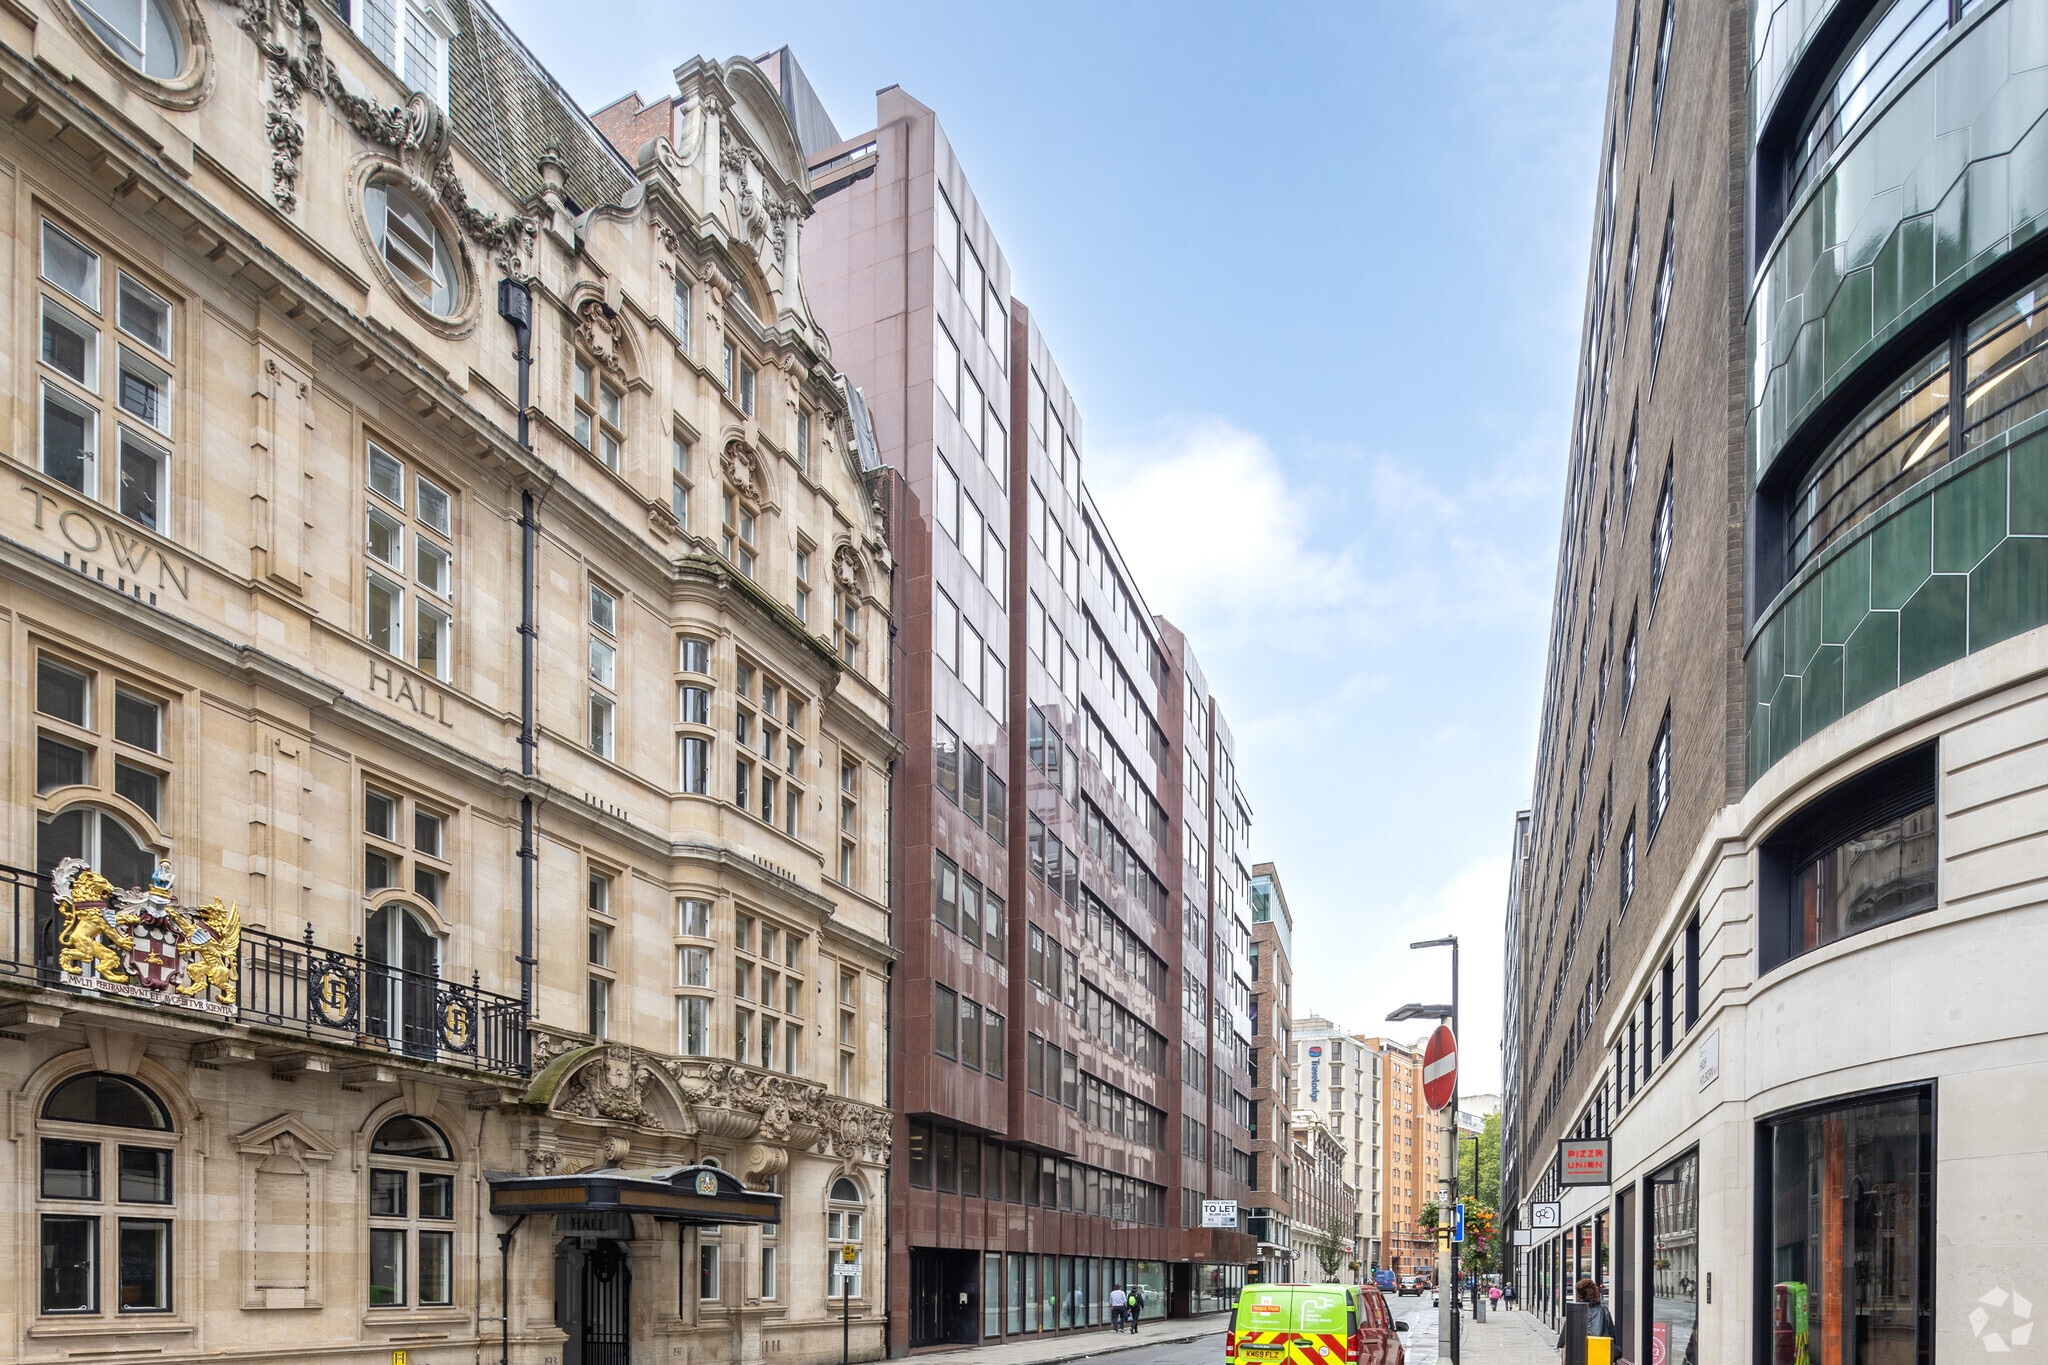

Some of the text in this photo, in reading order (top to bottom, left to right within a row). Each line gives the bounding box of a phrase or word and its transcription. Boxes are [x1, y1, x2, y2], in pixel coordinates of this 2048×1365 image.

[20, 483, 454, 729] TOWN HALL
[68, 975, 93, 988] MVLTI
[150, 993, 160, 1001] ET
[1309, 1058, 1320, 1103] Travelodge
[1567, 1149, 1603, 1159] PIZZA
[1567, 1161, 1603, 1169] UNION
[1203, 1205, 1236, 1213] TO LET
[571, 1217, 607, 1231] HALL
[1252, 1305, 1267, 1313] Royal
[1265, 1351, 1279, 1359] FLZ
